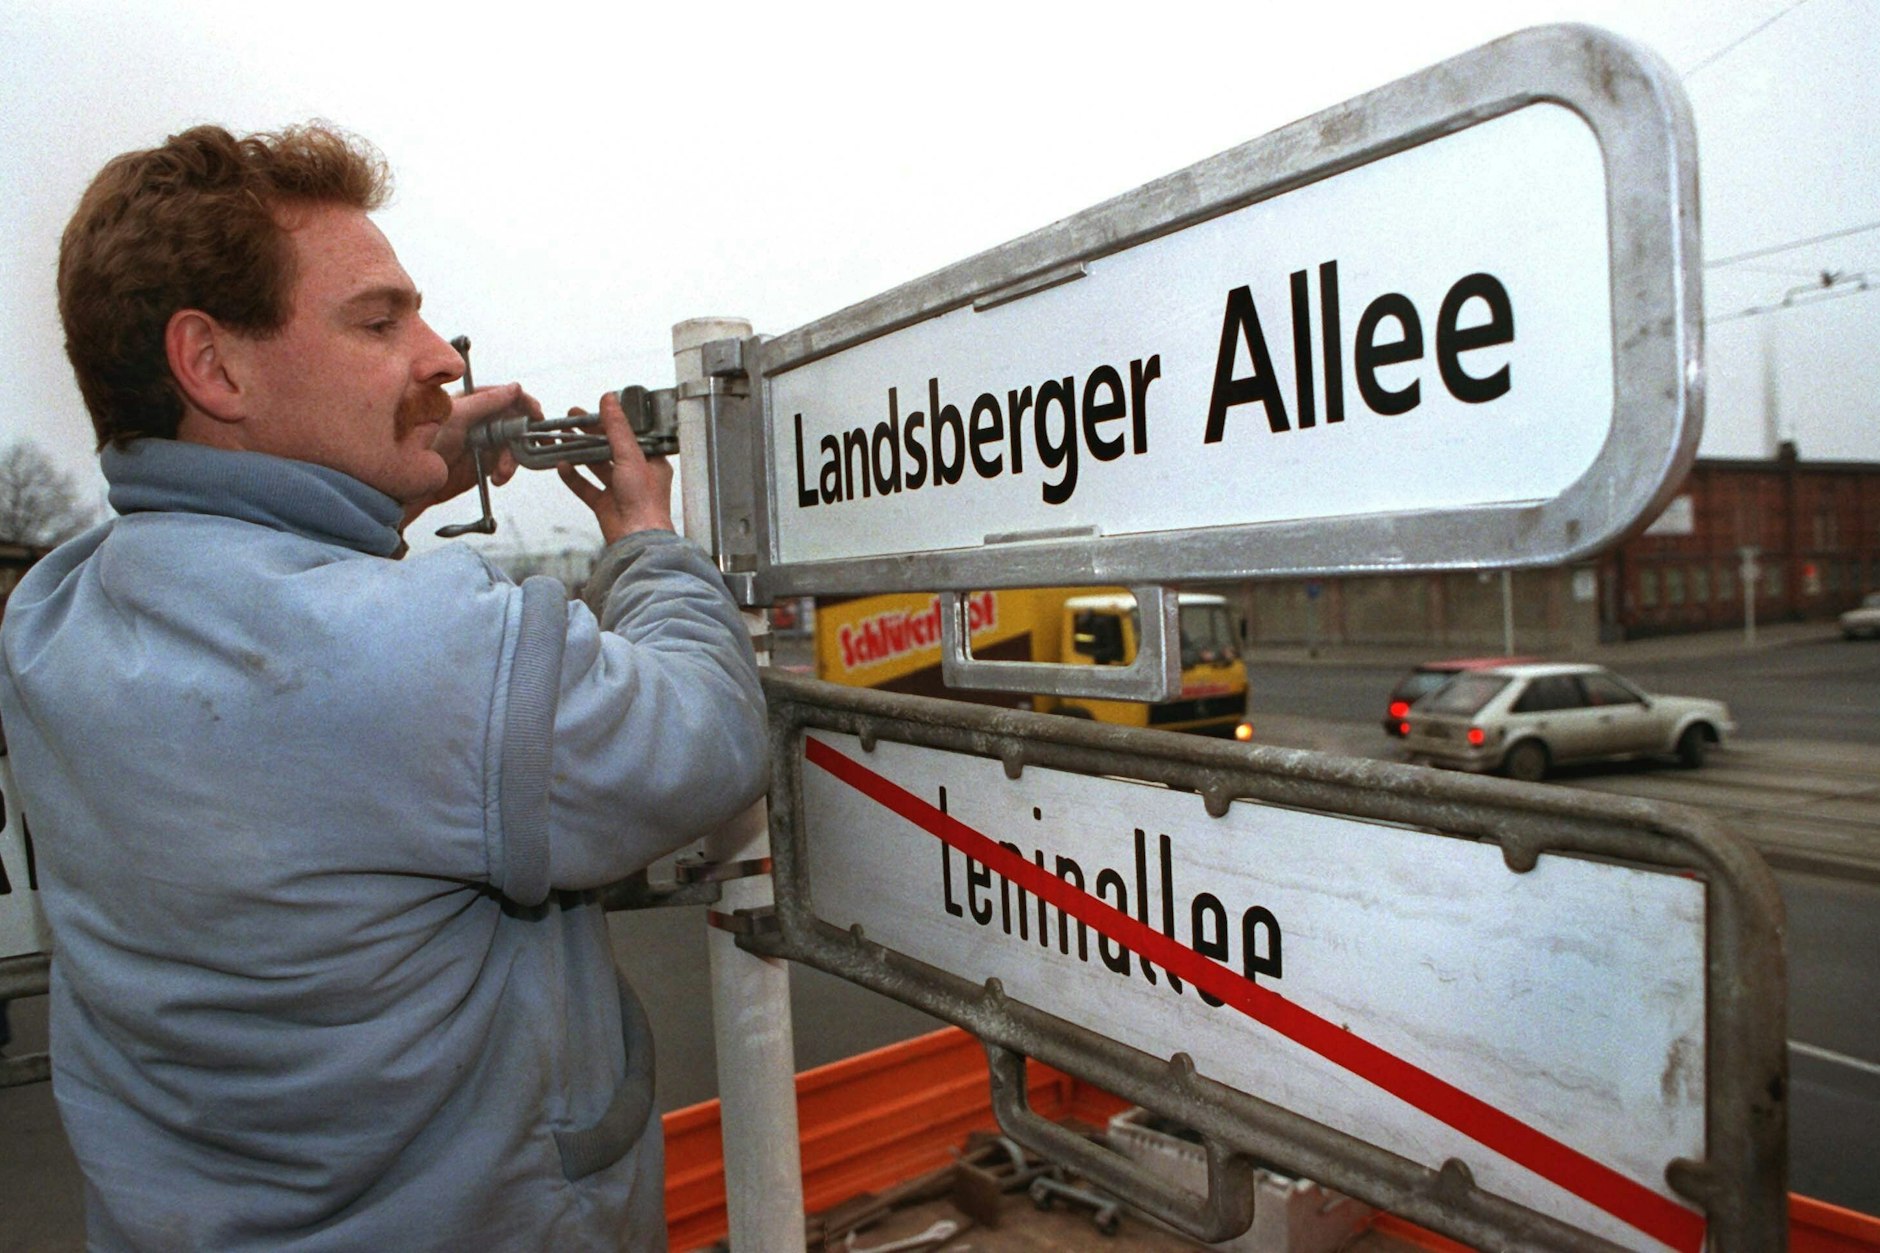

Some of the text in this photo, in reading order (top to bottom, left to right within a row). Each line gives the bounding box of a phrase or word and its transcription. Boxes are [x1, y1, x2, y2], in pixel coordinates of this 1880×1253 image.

[793, 259, 1515, 508] Landsberger Allee
[939, 785, 1283, 1008] Leninallee
